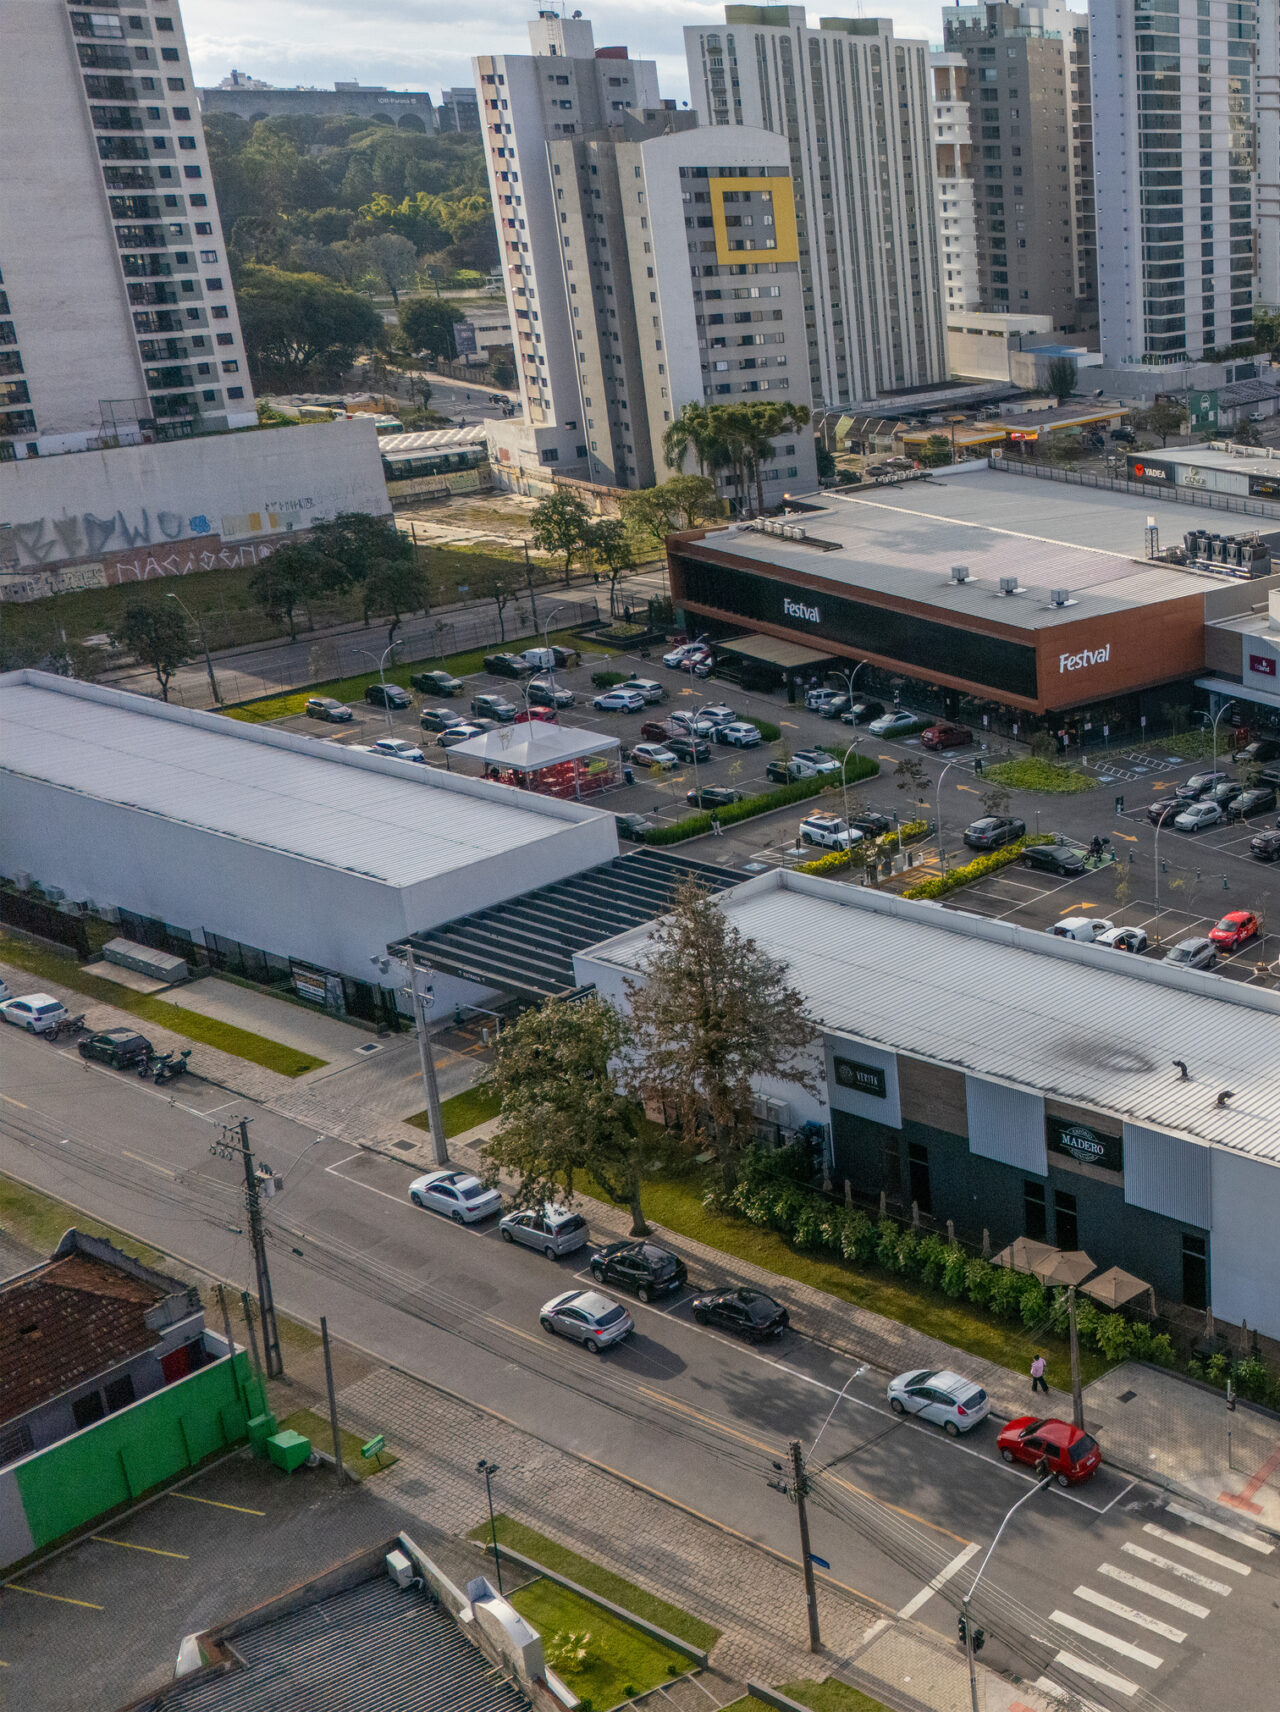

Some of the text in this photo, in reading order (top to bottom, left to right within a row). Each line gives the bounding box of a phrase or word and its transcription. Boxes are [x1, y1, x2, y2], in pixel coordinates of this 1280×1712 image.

[1144, 467, 1166, 479] YADEA
[783, 598, 820, 623] Festval
[1059, 644, 1110, 674] Festval
[1061, 1133, 1104, 1155] MADERO
